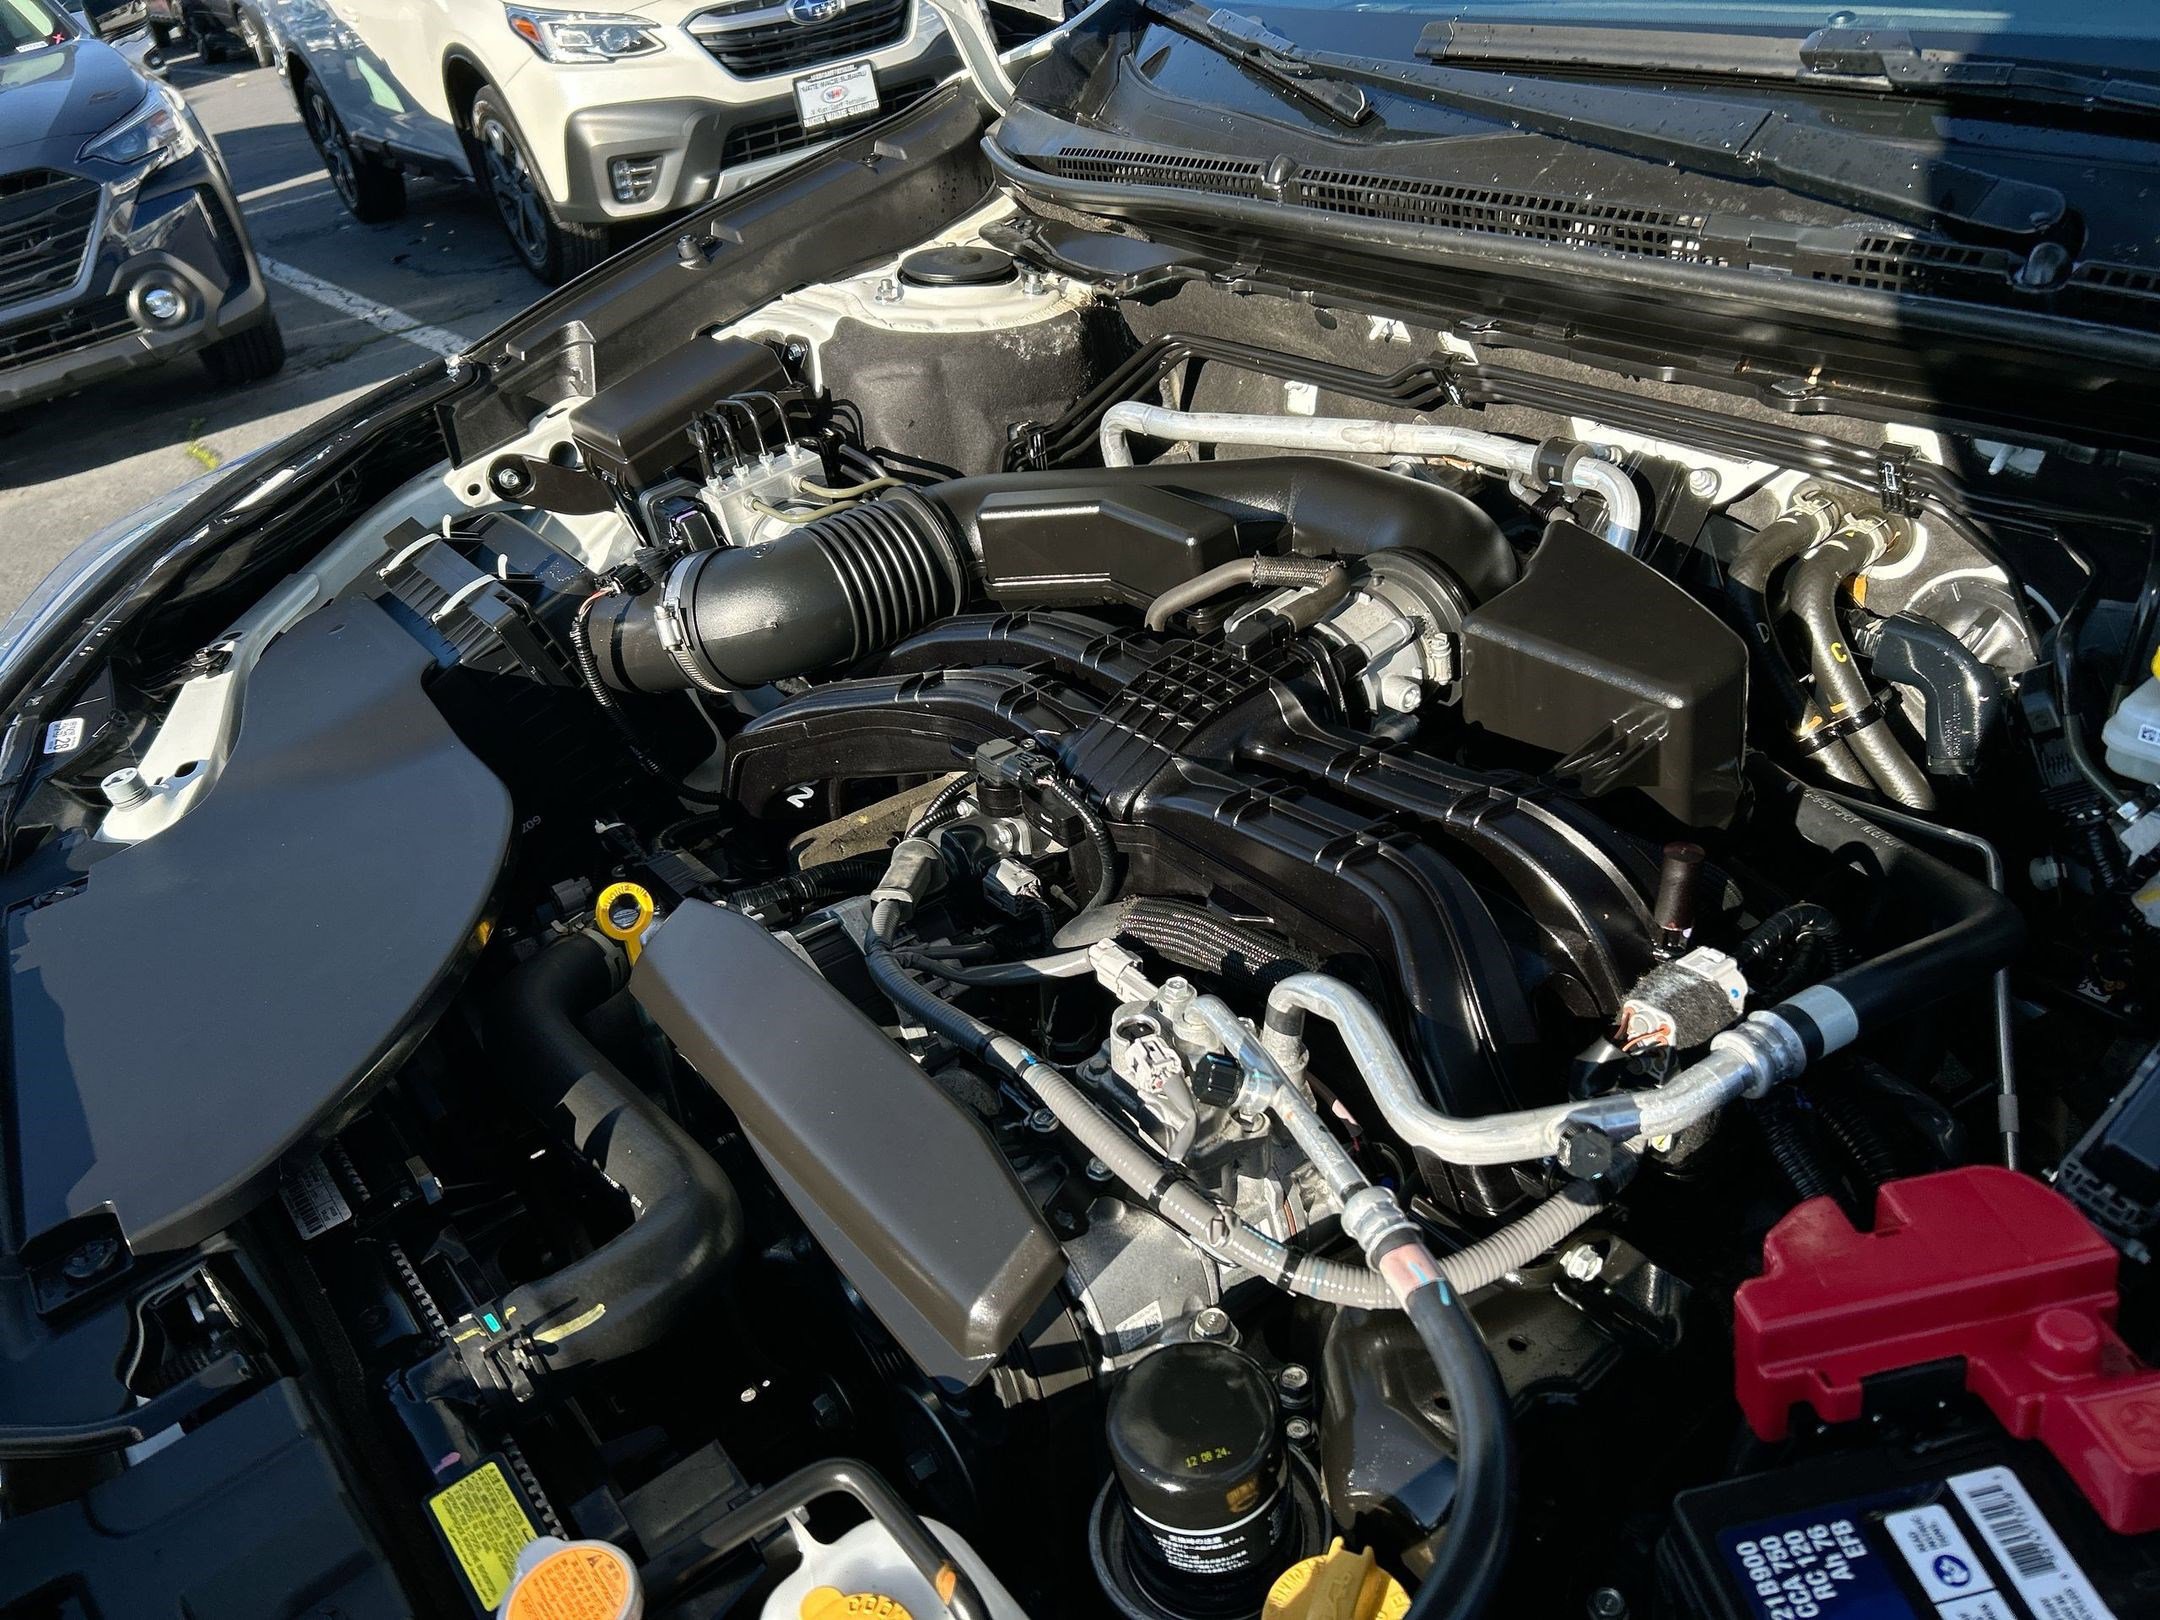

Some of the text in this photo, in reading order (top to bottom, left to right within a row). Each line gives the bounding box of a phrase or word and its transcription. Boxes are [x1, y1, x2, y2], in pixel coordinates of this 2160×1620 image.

[1831, 641, 1847, 663] C
[786, 786, 814, 808] 2
[1806, 1523, 1856, 1580] Ah 76
[1830, 1518, 1868, 1559] EFB
[1760, 1535, 1820, 1619] CCA 750
[1782, 1529, 1838, 1601] RC 120
